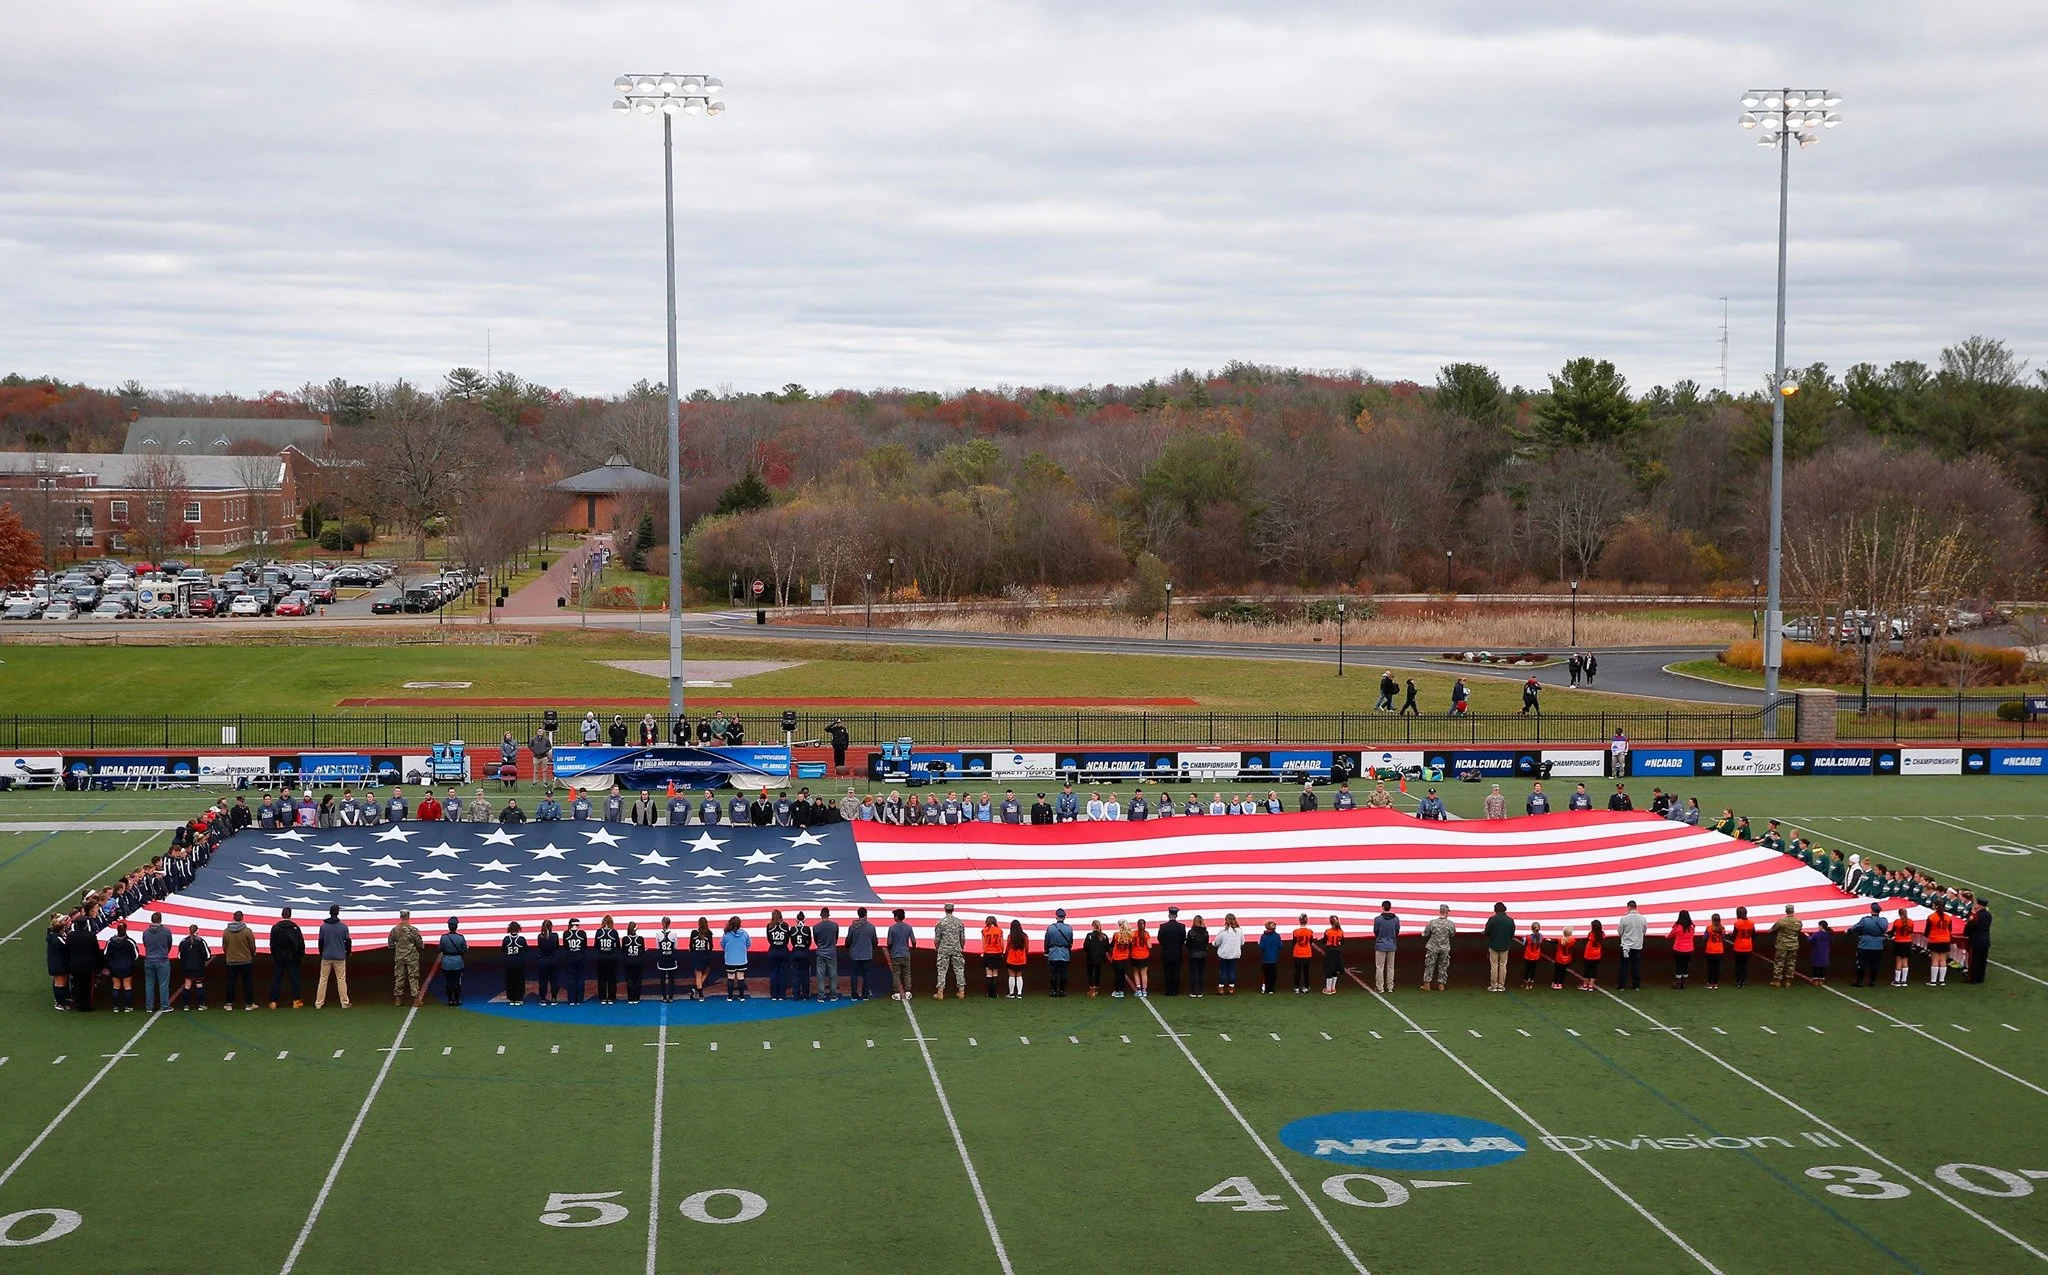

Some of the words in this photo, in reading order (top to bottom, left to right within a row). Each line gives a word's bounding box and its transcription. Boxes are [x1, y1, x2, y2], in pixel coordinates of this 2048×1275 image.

[1190, 761, 1238, 769] CHAMPIONSHIPS
[1283, 760, 1322, 769] #NCAAD2
[1455, 759, 1513, 769] NCAA.COM/D2
[1644, 758, 1684, 768] #NCAAD2
[1753, 760, 1781, 773] YOURS
[1814, 757, 1871, 767] NCAA.COM/D2
[2002, 756, 2042, 767] #NCAAD2
[99, 765, 166, 775] NCAA.COM/D2
[567, 939, 581, 948] 102
[599, 938, 612, 948] 118
[661, 941, 672, 951] 82
[1313, 1136, 1527, 1155] NCAA
[1537, 1133, 1796, 1152] Division
